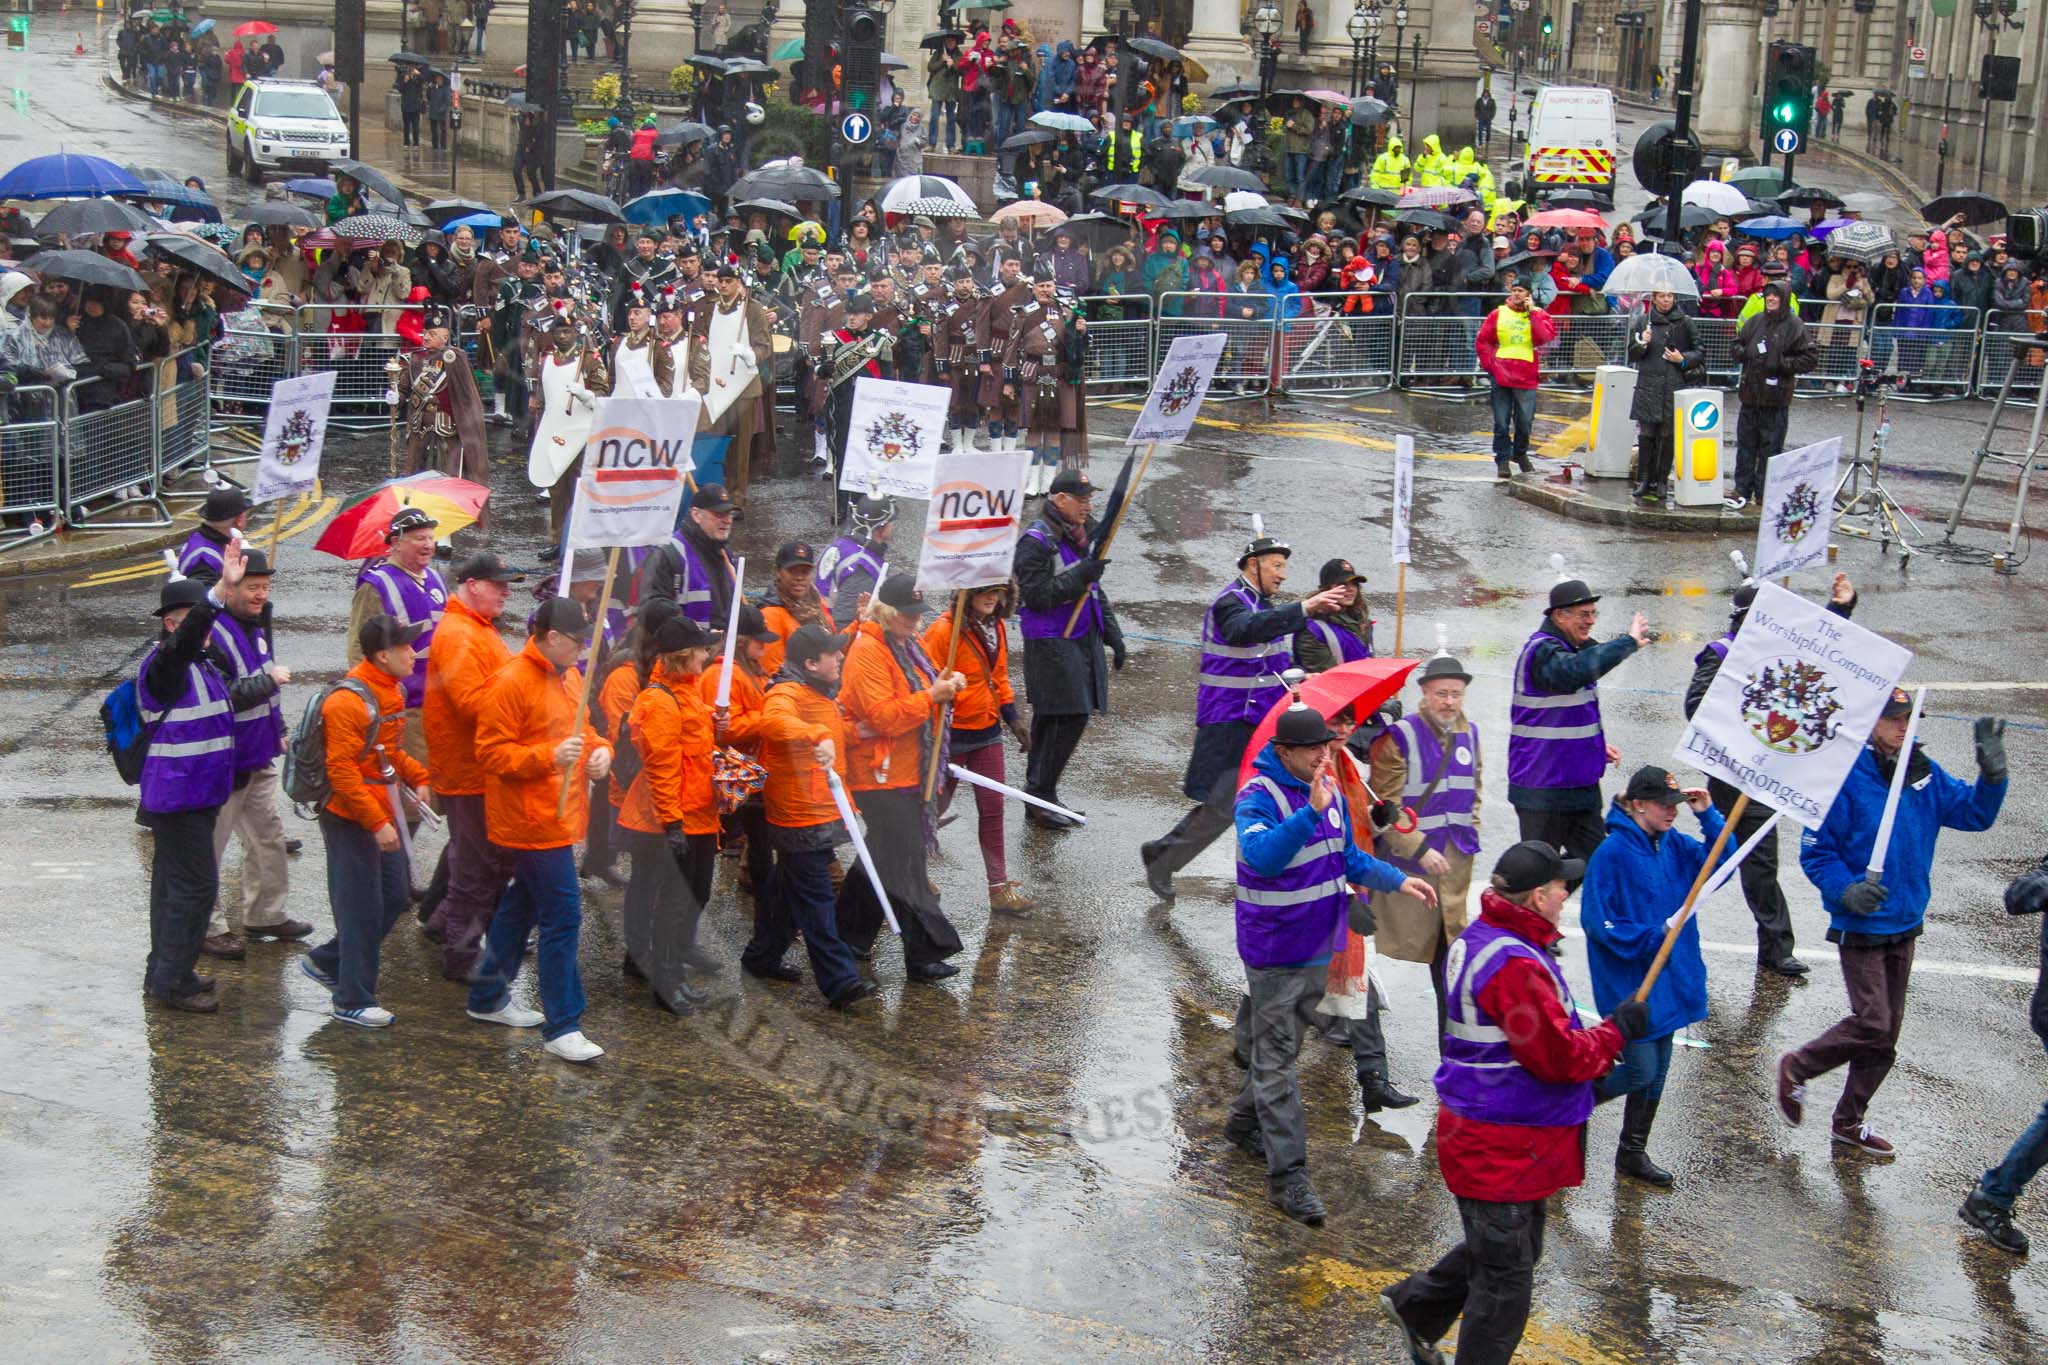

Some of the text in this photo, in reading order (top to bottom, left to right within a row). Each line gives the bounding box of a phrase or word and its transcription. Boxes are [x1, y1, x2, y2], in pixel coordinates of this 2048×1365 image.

[597, 439, 684, 469] ncw
[940, 489, 1015, 518] ncw
[1818, 619, 1842, 641] The
[1755, 610, 1890, 690] Worshipful Company
[1687, 731, 1822, 816] Lightmongers
[1752, 754, 1768, 766] of
